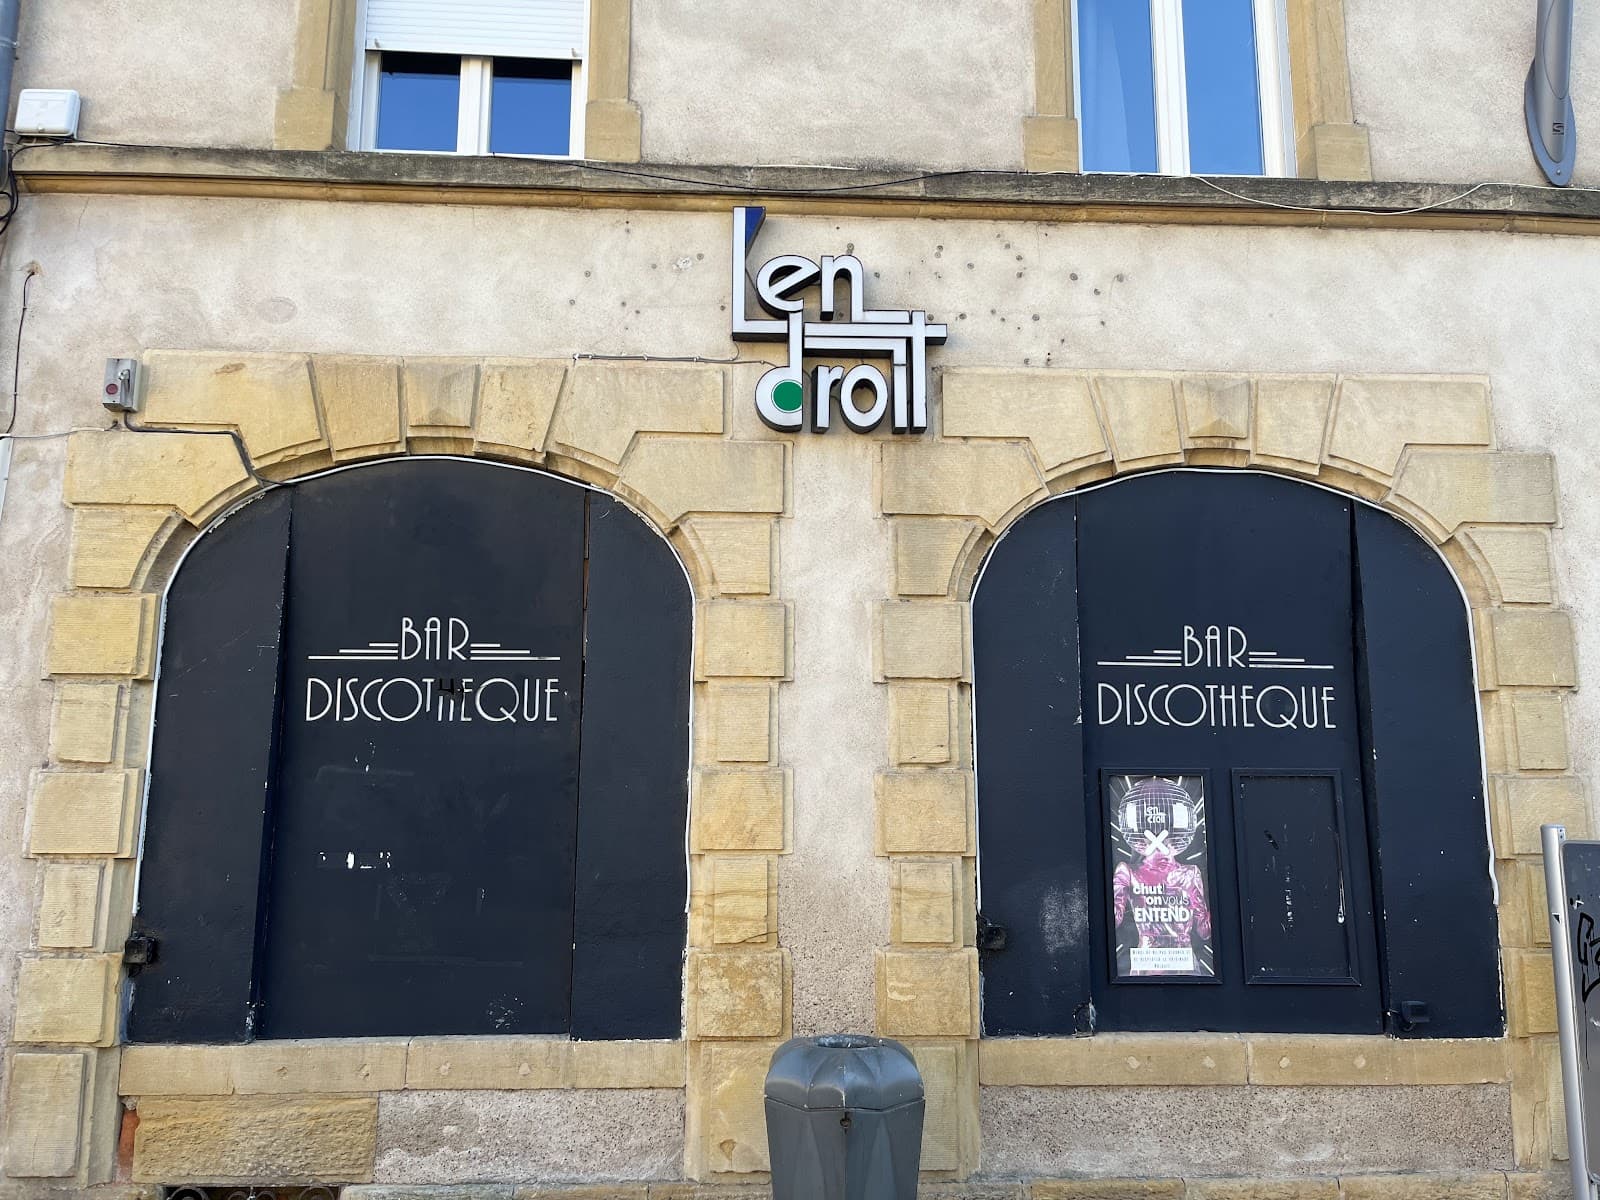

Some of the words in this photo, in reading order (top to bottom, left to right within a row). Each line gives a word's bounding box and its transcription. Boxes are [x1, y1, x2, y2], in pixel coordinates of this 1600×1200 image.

[401, 616, 470, 661] BAR
[1183, 625, 1246, 668] BAR
[1097, 683, 1337, 729] DISCOTHEQUE
